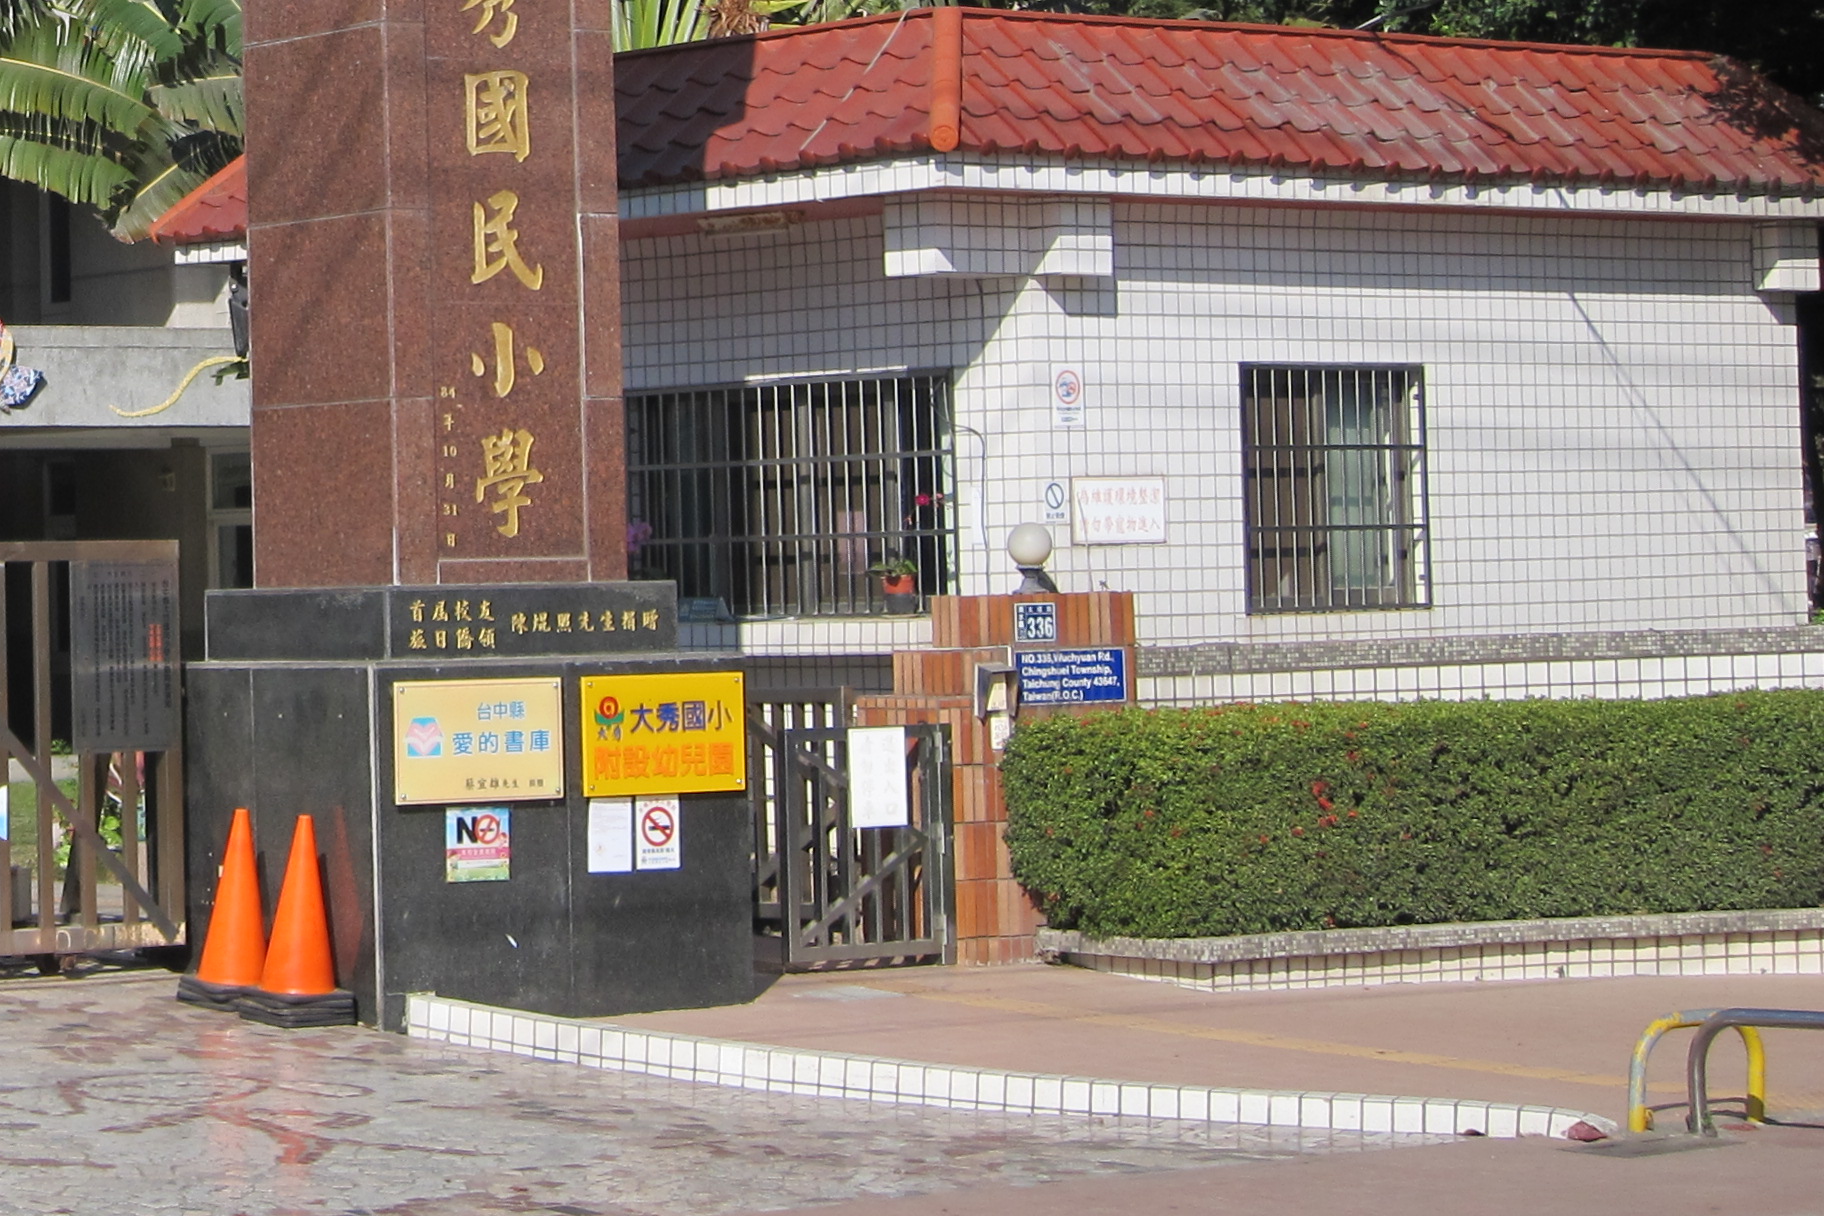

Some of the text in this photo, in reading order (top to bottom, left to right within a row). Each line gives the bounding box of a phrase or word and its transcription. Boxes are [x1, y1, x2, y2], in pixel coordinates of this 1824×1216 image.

[1027, 616, 1053, 638] 336
[1062, 677, 1092, 689] County
[477, 701, 526, 721] 台中縣
[630, 700, 733, 734] 大秀國小
[452, 729, 551, 756] 愛的書庫
[594, 742, 734, 780] 附設幼兒園
